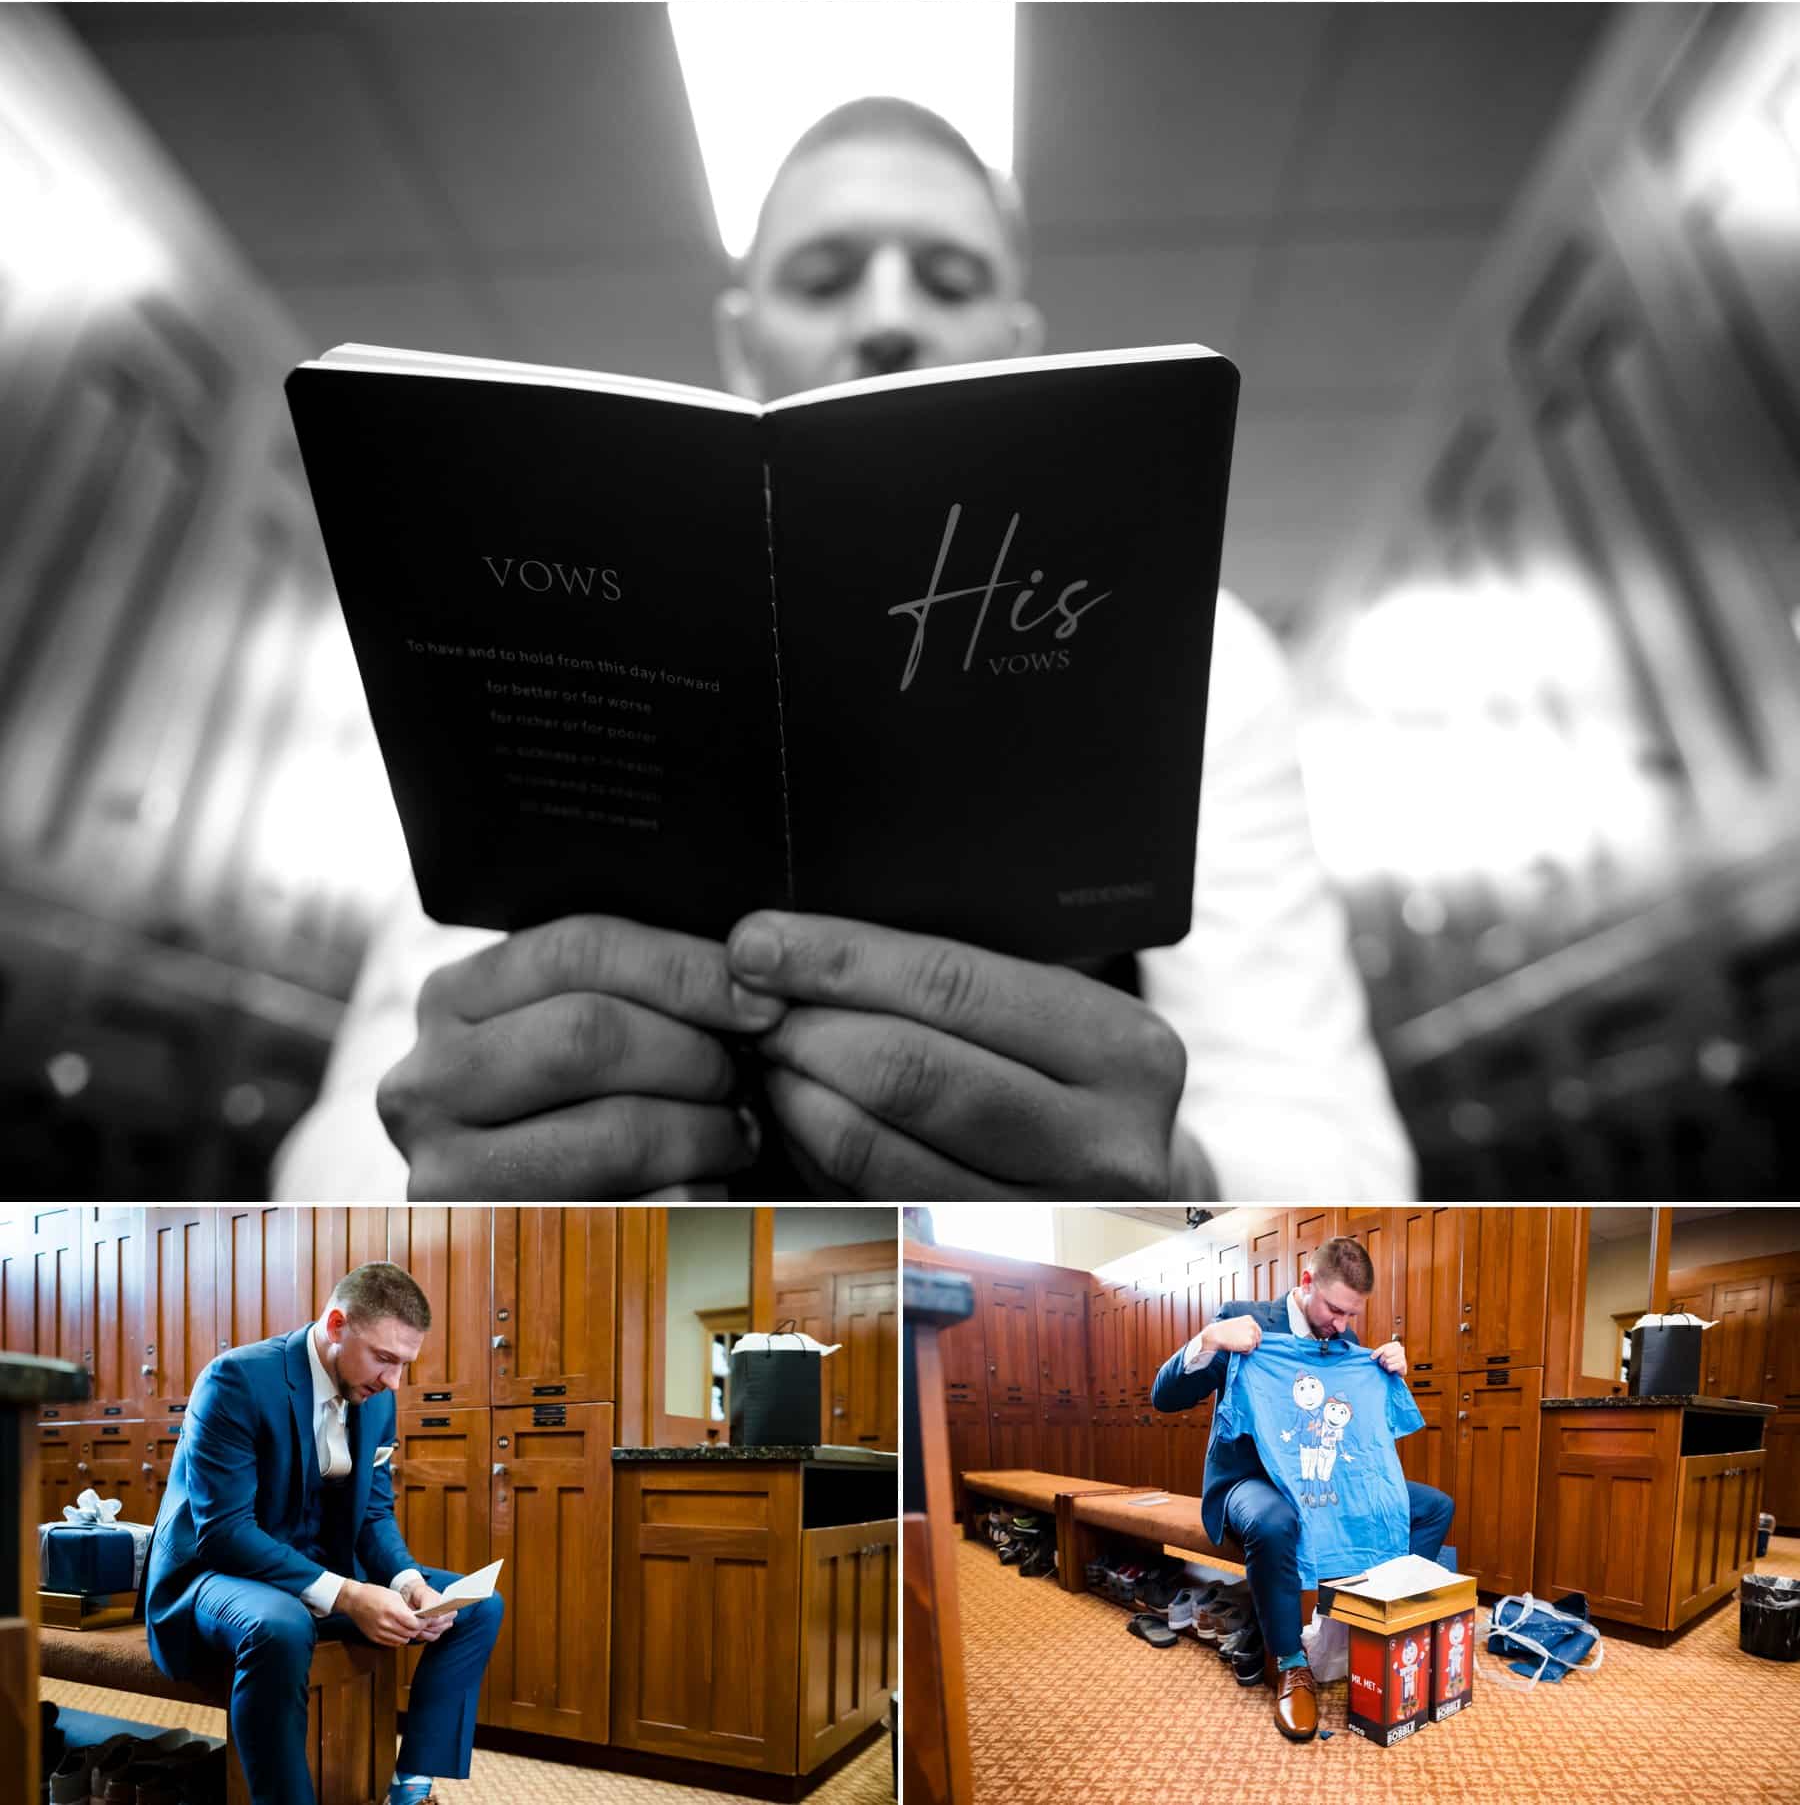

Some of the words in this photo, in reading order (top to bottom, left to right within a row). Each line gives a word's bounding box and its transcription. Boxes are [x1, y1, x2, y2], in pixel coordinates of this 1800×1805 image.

[481, 556, 622, 602] VOWS
[888, 503, 1112, 692] His
[405, 637, 425, 653] To
[427, 642, 464, 657] have
[466, 645, 496, 660] and
[499, 649, 516, 662] to
[519, 650, 554, 667] hold
[557, 652, 594, 671] from
[598, 658, 626, 675] this
[630, 664, 657, 683] day
[659, 668, 720, 692] forward
[988, 648, 1071, 676] VOWS
[485, 679, 508, 694] for
[511, 682, 558, 700] better
[562, 691, 578, 703] or
[581, 691, 604, 707] for
[607, 697, 653, 716] worse
[1364, 1678, 1377, 1692] MET
[1387, 1720, 1415, 1746] BOBBLE
